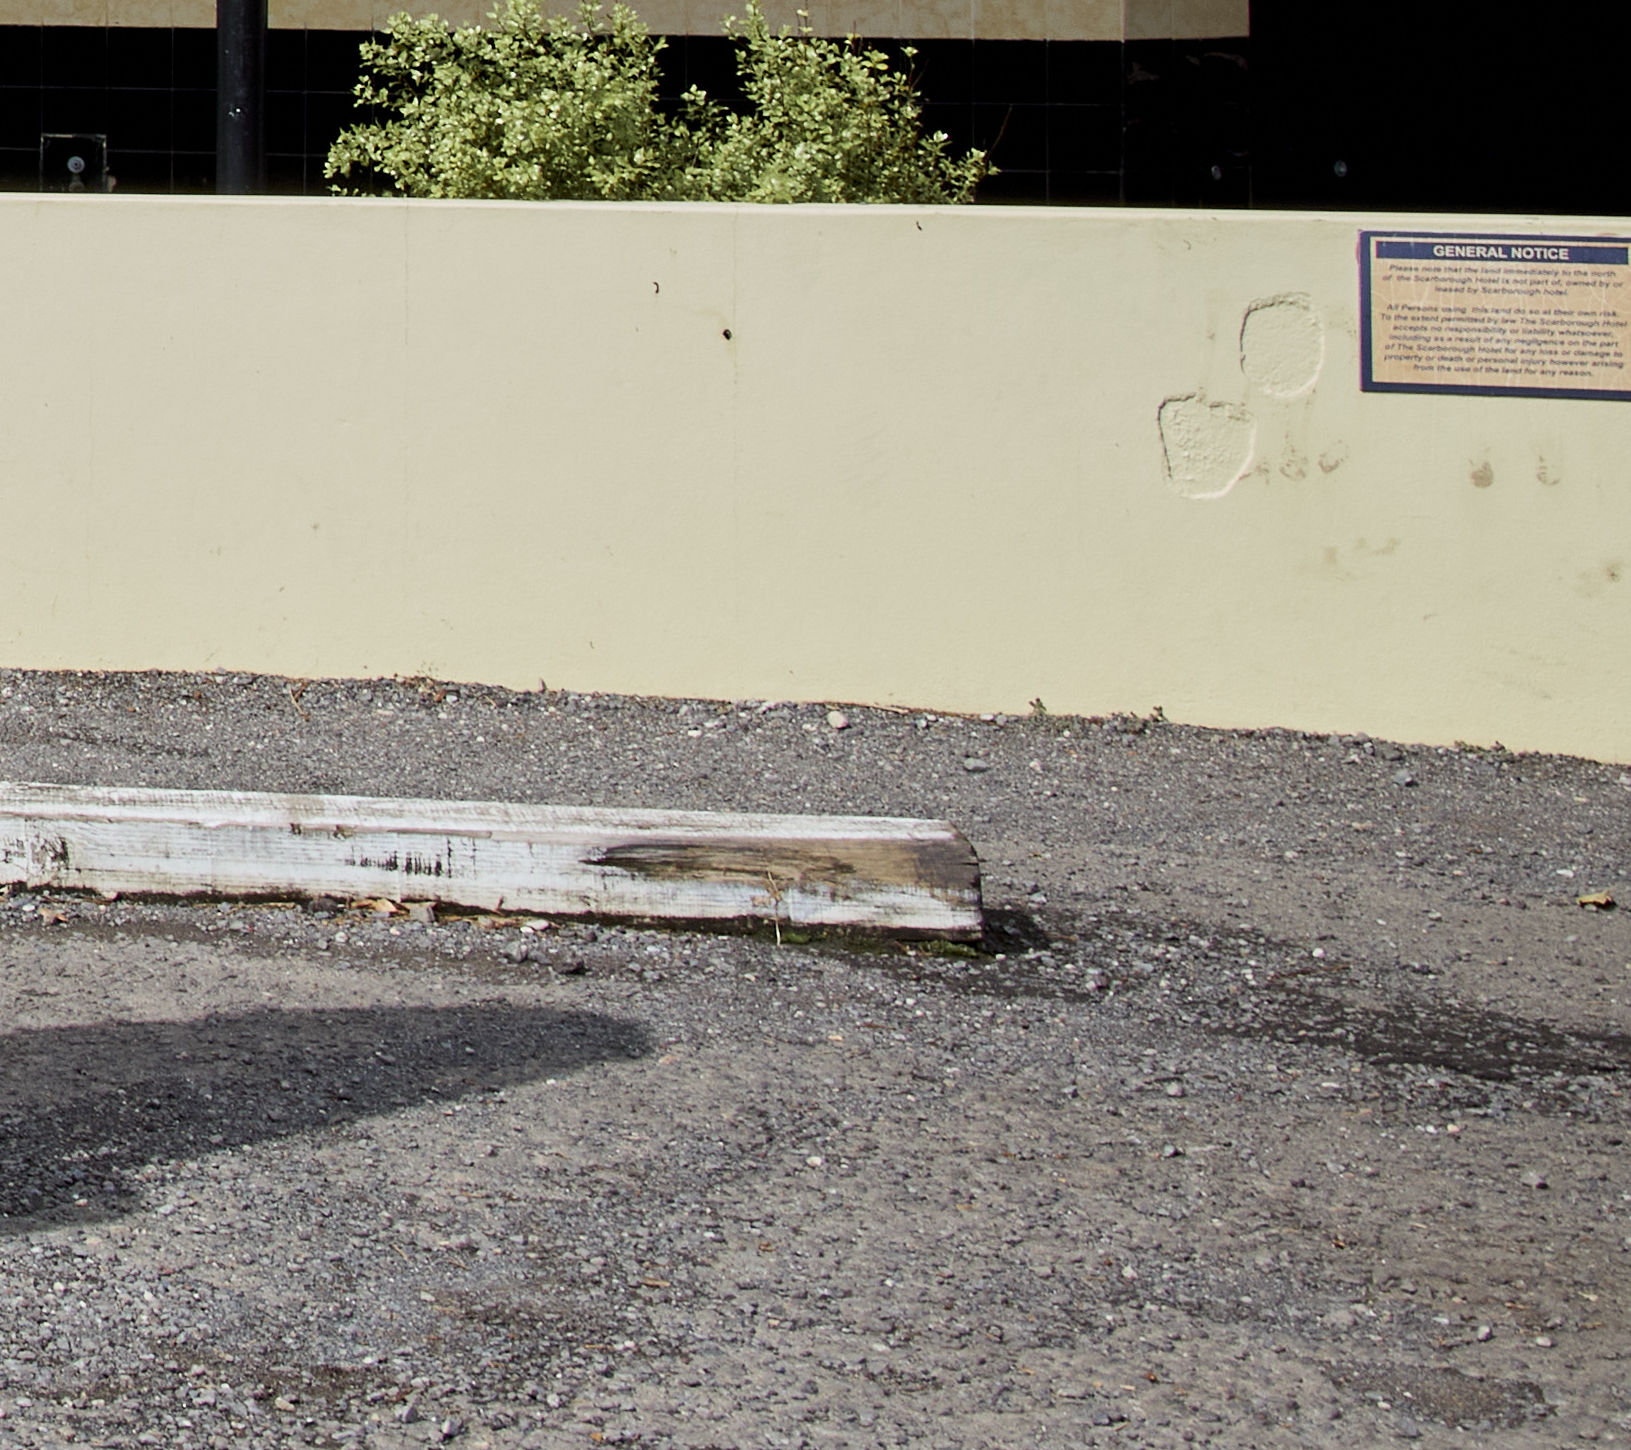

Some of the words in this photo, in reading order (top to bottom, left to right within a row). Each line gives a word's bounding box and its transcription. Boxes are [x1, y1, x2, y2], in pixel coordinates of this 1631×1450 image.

[1433, 245, 1507, 258] GENERAL
[1511, 247, 1569, 259] NOTICE
[1414, 275, 1472, 284] Scarborough
